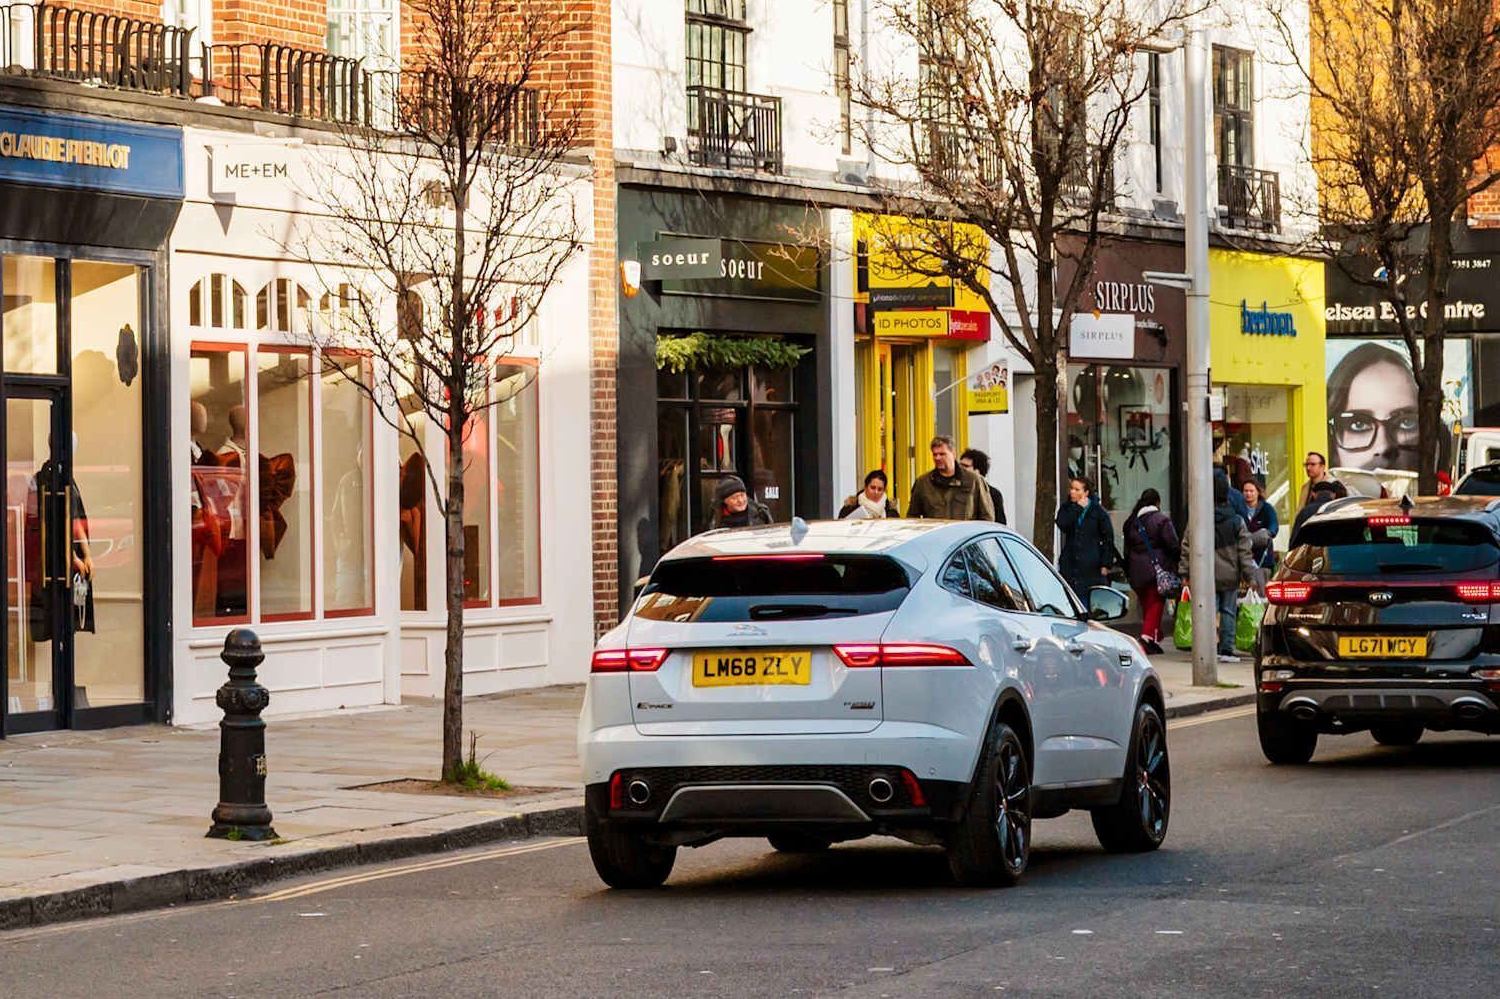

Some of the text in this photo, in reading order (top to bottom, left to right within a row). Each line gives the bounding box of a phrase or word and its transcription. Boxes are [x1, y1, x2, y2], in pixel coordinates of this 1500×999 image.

[66, 139, 131, 170] PIERLOT
[225, 163, 287, 178] ME+EM
[651, 252, 711, 267] soeur
[720, 258, 764, 280] soeur
[1096, 281, 1156, 313] SIRPLUS
[1419, 301, 1485, 320] Cntre
[879, 318, 891, 329] ID
[894, 318, 941, 329] PHOTOS
[1079, 329, 1124, 341] SIRPLUS
[1251, 450, 1269, 475] SALE
[1350, 638, 1383, 653] LG71
[703, 656, 756, 677] LM68
